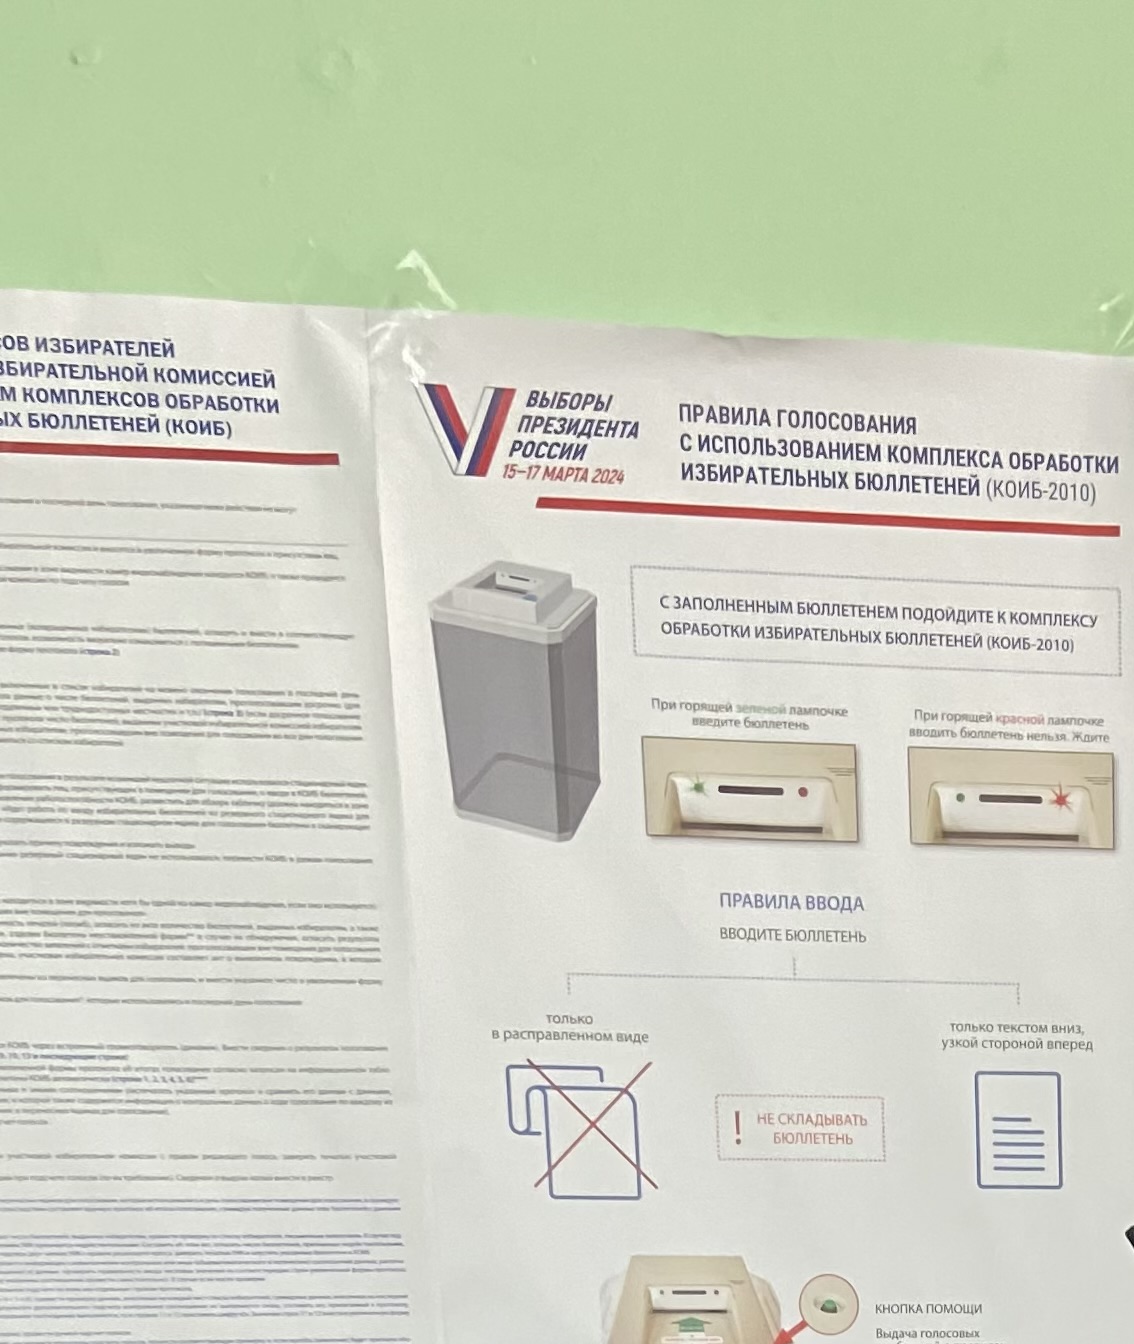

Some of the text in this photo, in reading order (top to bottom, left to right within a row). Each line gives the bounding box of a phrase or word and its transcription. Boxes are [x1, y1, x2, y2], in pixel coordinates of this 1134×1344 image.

[0, 335, 175, 358] ОВ ИЗБИРАТЕЛЕЙ
[154, 369, 275, 388] КОМИССИЕЙ
[23, 387, 160, 408] КОМПЛЕКСОВ
[166, 395, 280, 414] ОБРАБОТКИ
[525, 389, 614, 413] ВЫБОРЫ
[28, 414, 160, 433] БЮЛЛЕТЕНЕЙ
[166, 419, 232, 439] (КОИБ)
[517, 414, 640, 440] ПРЕЗИДЕНТА
[679, 403, 917, 436] ПРАВИЛА ГОЛОСОВАНИЯ
[508, 439, 588, 462] РОССИИ
[679, 434, 1120, 474] С ИСПОЛЬЗОВАНИЕМ КОМПЛЕКСА ОБРАБОТКИ
[541, 465, 589, 483] МАРТА
[590, 467, 625, 485] 2024
[681, 463, 1097, 506] ИЗБИРАТЕЛЬНЫХ БЮЛЛЕТЕНЕЙ (КОИБ-2010)
[660, 594, 1098, 629] С ЗАПОЛНЕННЫМ БЮЛЛЕТЕНЕМ ПОДОЙДИТЕ К КОМПЛЕКСУ
[661, 620, 1074, 654] ОБРАБОТКИ ИЗБИРАТЕЛЬНЫХ БЮЛЛЕТЕНЕЙ (КОИБ-2010)
[651, 697, 676, 711] При
[679, 701, 733, 714] горящей
[789, 705, 849, 718] лампочке
[914, 708, 1105, 727] При горящей красной лампочке
[692, 716, 810, 731] введите бюллетень
[909, 726, 1110, 743] вводить бюллетень нельзя. Ждите
[720, 892, 865, 914] ПРАВИЛА ВВОДА
[720, 926, 867, 945] ВВОДИТЕ БЮЛЛЕТЕНЬ
[546, 1014, 593, 1026] только
[950, 1022, 1085, 1037] только текстом вниз,
[492, 1028, 649, 1045] в расправленном виде
[941, 1035, 1094, 1054] узкой стороной вперед
[757, 1112, 867, 1130] НЕ СКЛАДЫВАТЬ
[773, 1132, 854, 1146] БЮЛЛЕТЕНЬ
[875, 1303, 983, 1317] КНОПКА ПОМОЩИ
[876, 1328, 980, 1341] Выдача голосовых
